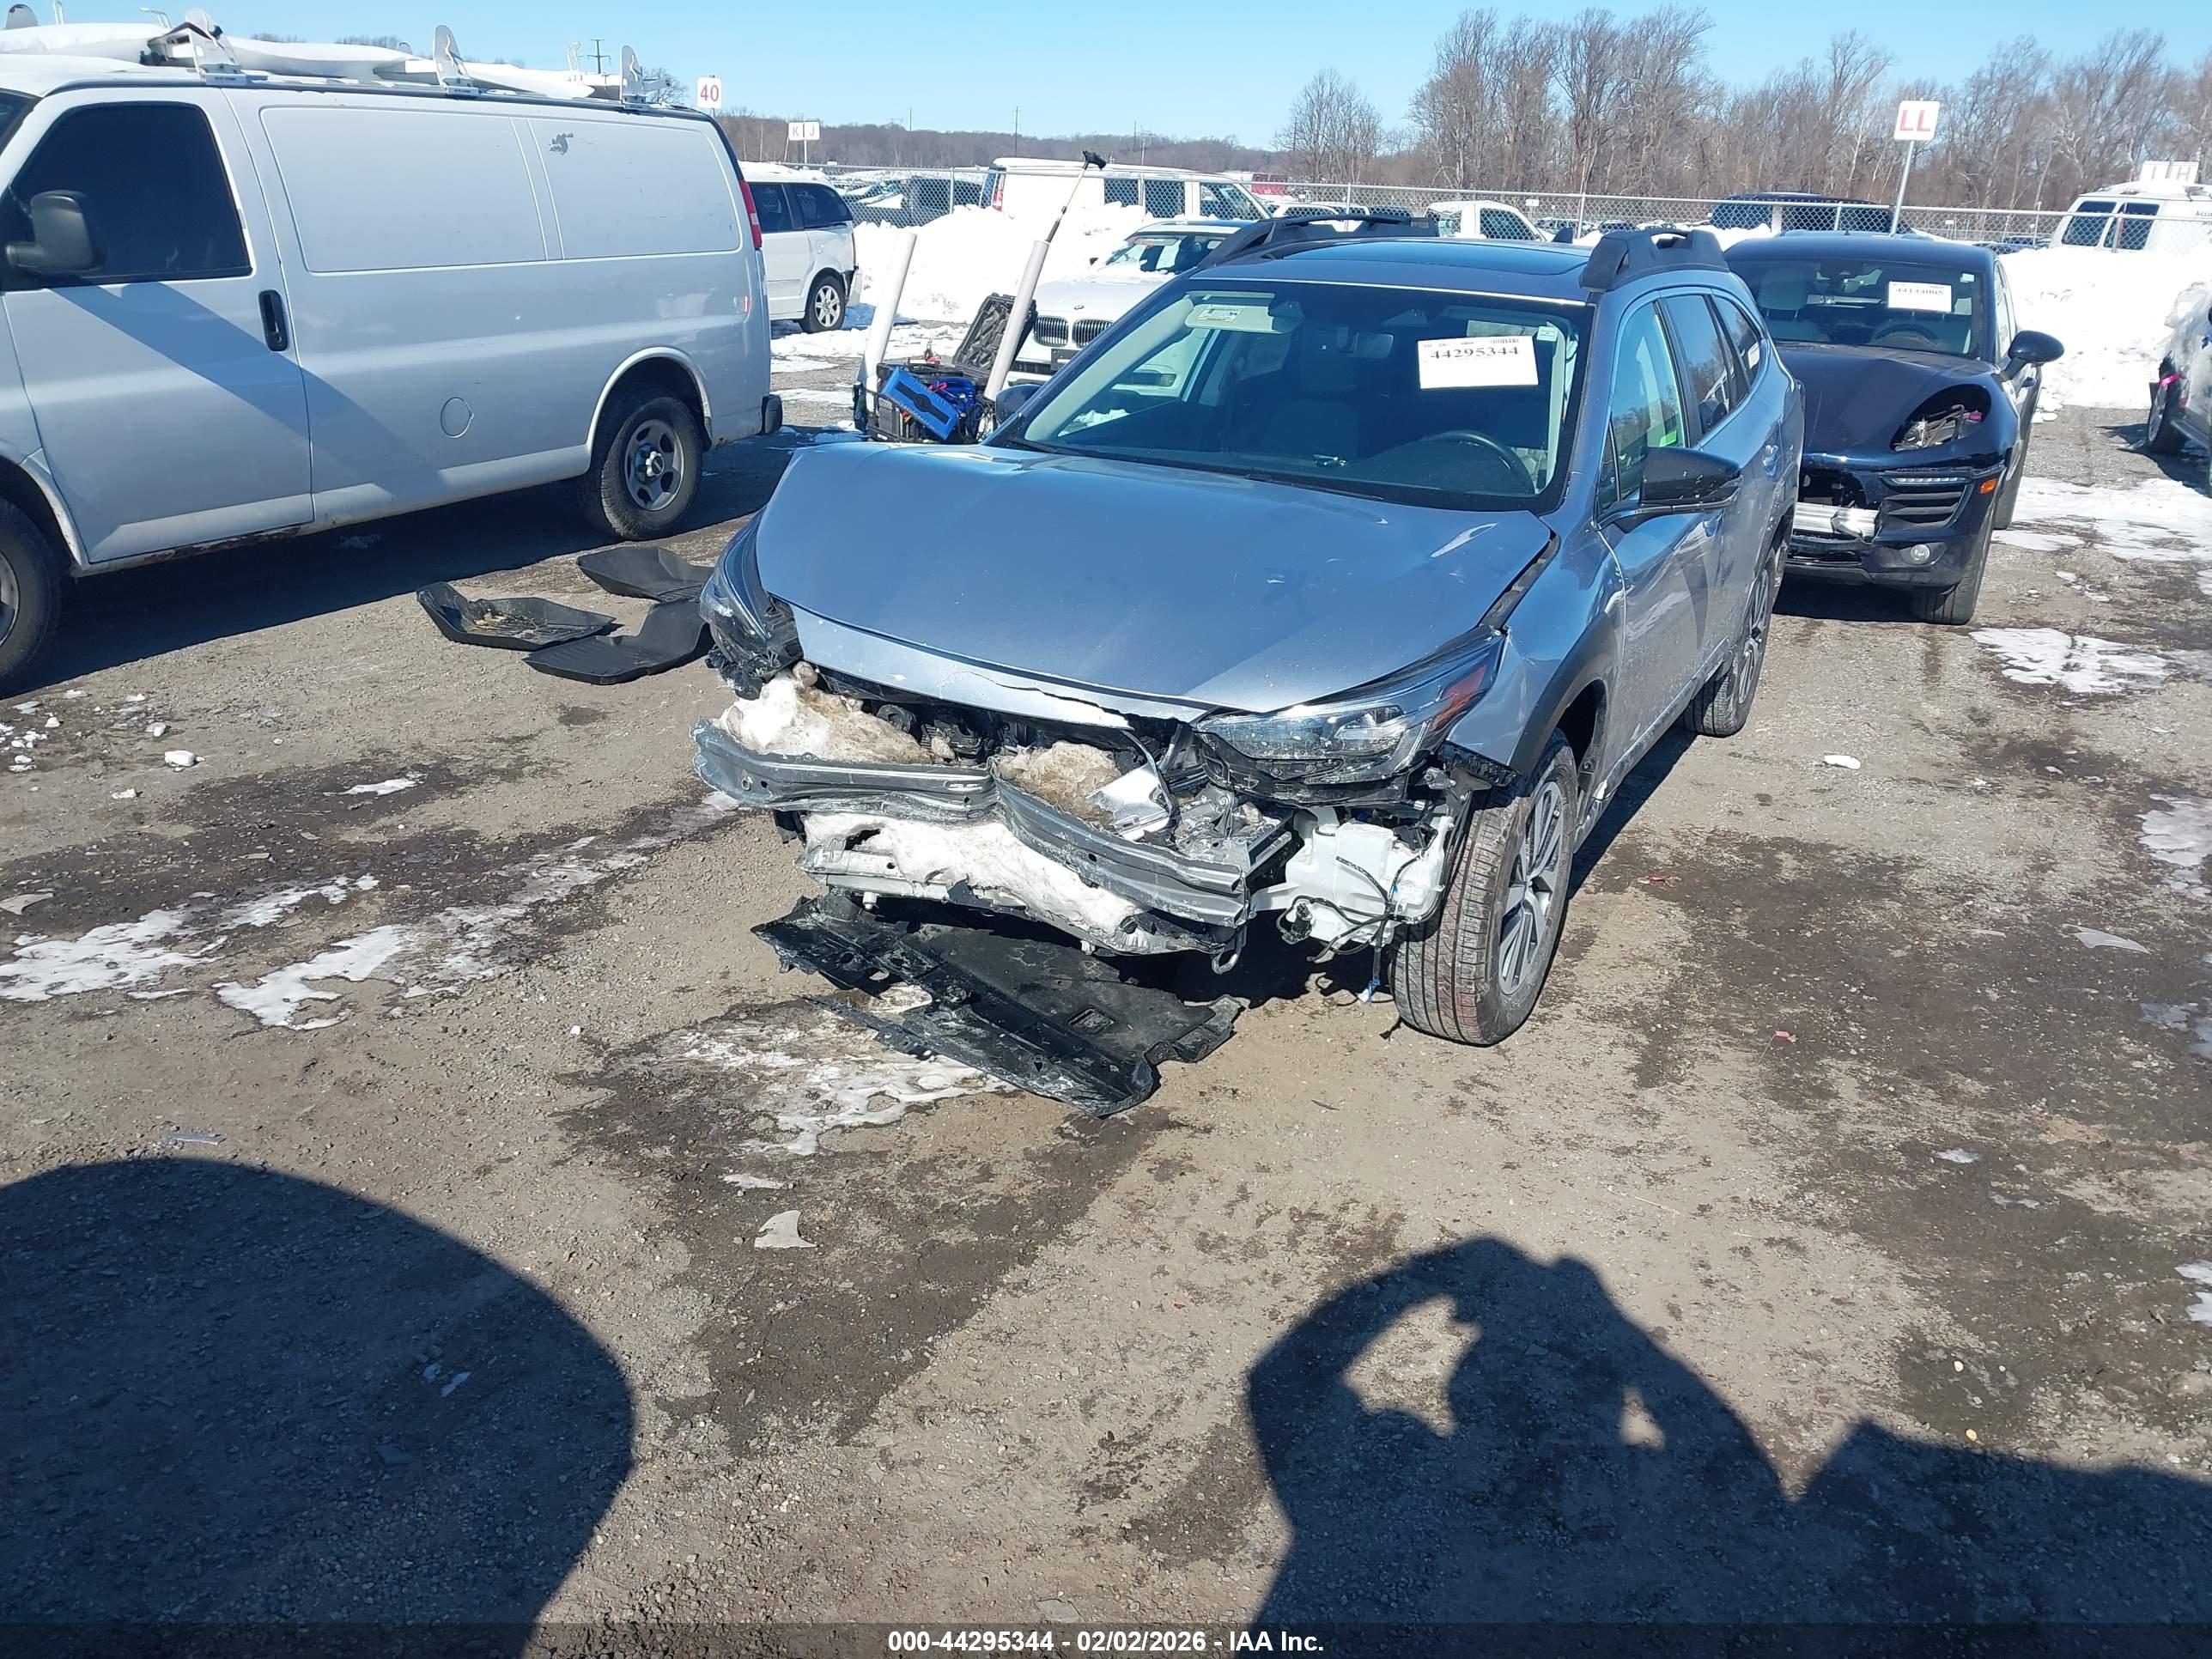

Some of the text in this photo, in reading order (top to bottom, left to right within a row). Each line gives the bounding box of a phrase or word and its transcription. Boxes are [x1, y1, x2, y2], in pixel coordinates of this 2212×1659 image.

[700, 84, 720, 102] 40
[1899, 109, 1931, 131] LL
[793, 125, 800, 137] K
[810, 125, 815, 137] J
[2176, 166, 2191, 181] H
[1430, 346, 1519, 359] 44295344
